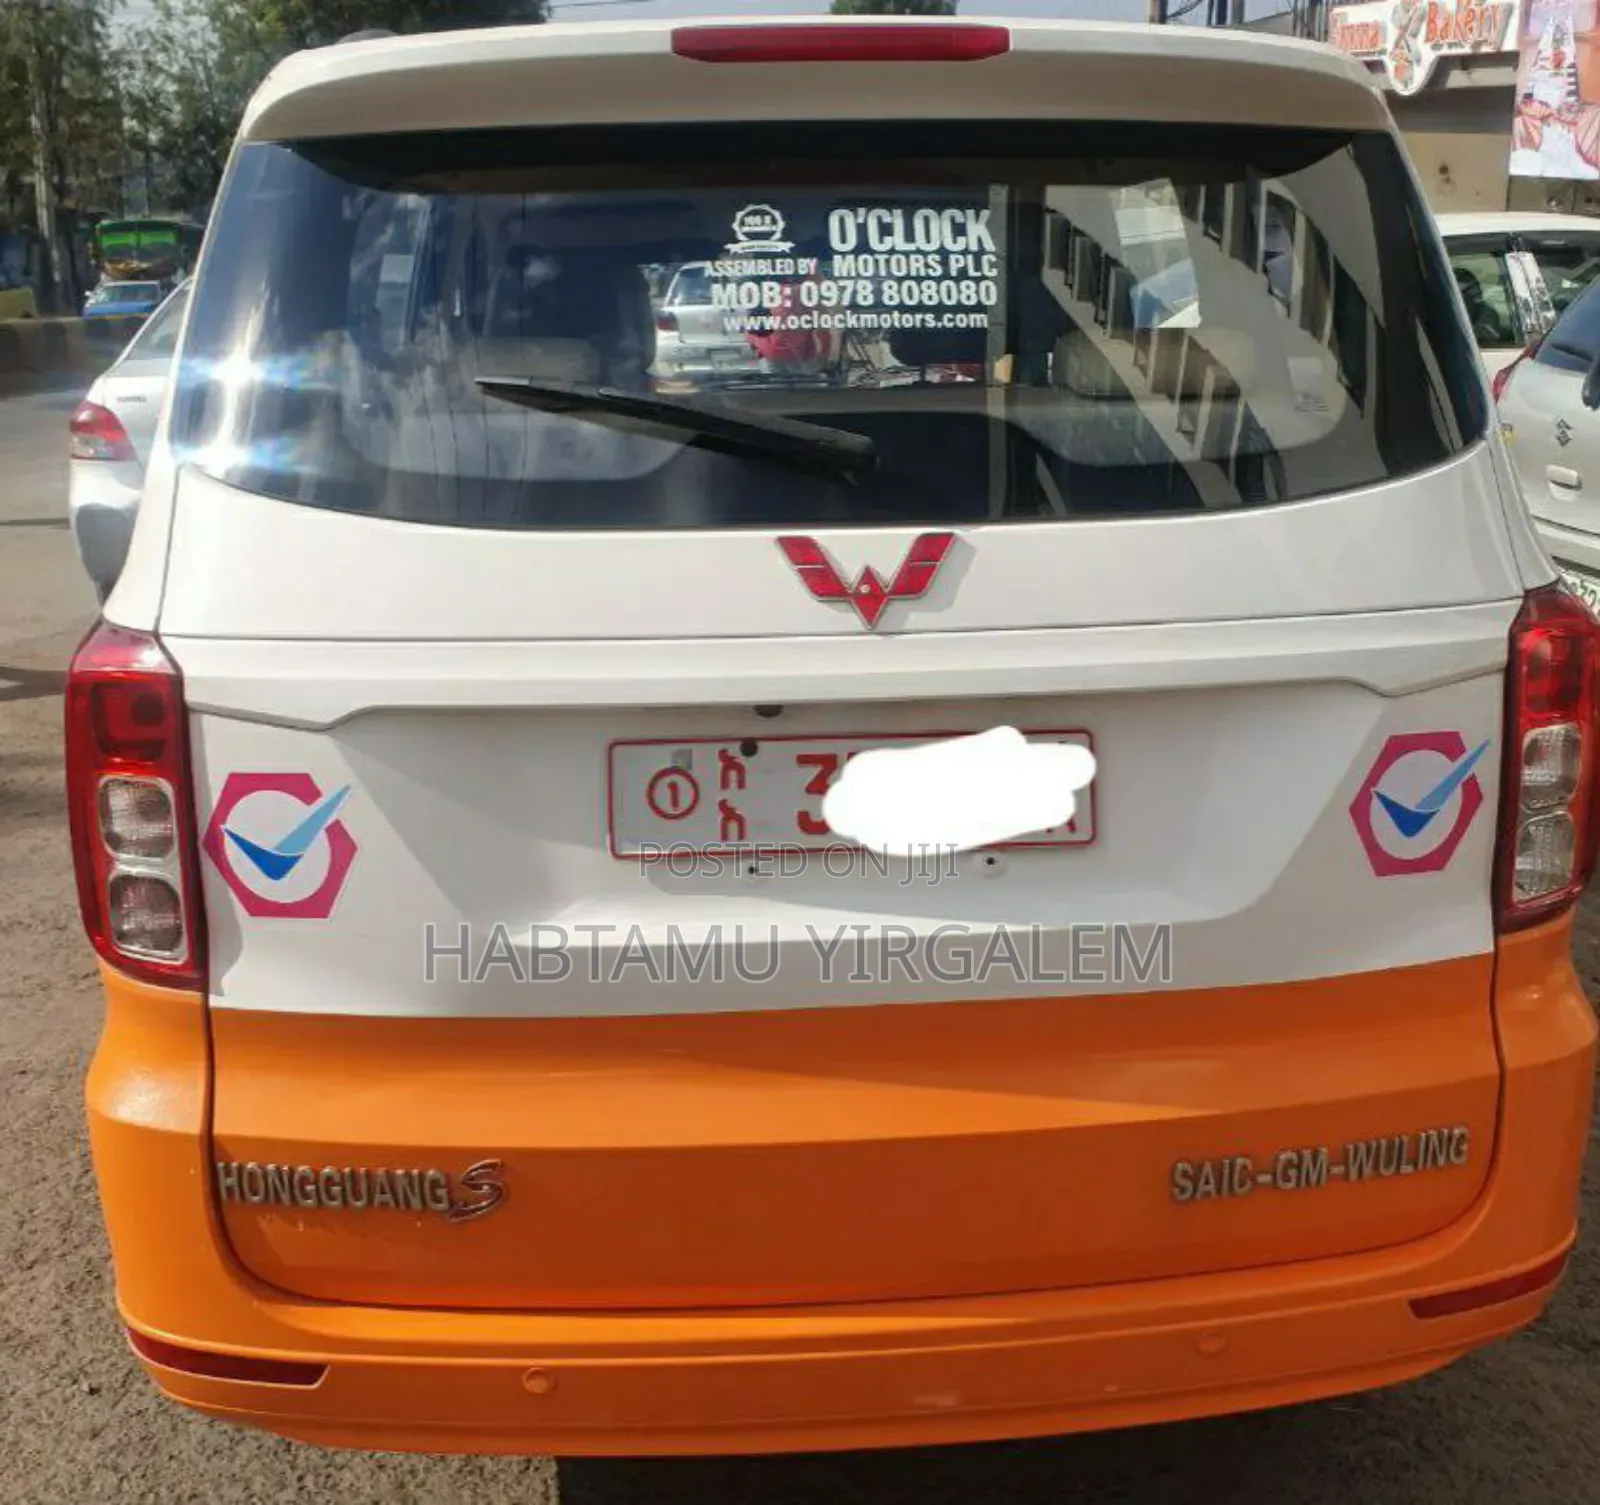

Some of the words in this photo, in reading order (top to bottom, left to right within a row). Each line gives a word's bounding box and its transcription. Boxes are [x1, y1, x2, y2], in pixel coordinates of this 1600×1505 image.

[828, 207, 996, 252] O'CLOCK
[704, 257, 796, 277] ASSEMBLED
[798, 256, 817, 275] BY
[832, 254, 943, 277] MOTORS
[949, 254, 998, 277] PLC
[710, 281, 792, 309] MOB:
[800, 279, 874, 306] 0978
[881, 279, 998, 306] 808080
[723, 310, 988, 330] www.oclockmotors.com
[1171, 1125, 1469, 1201] SAIC-GM-WULING
[217, 1160, 451, 1213] HONGGUANG
